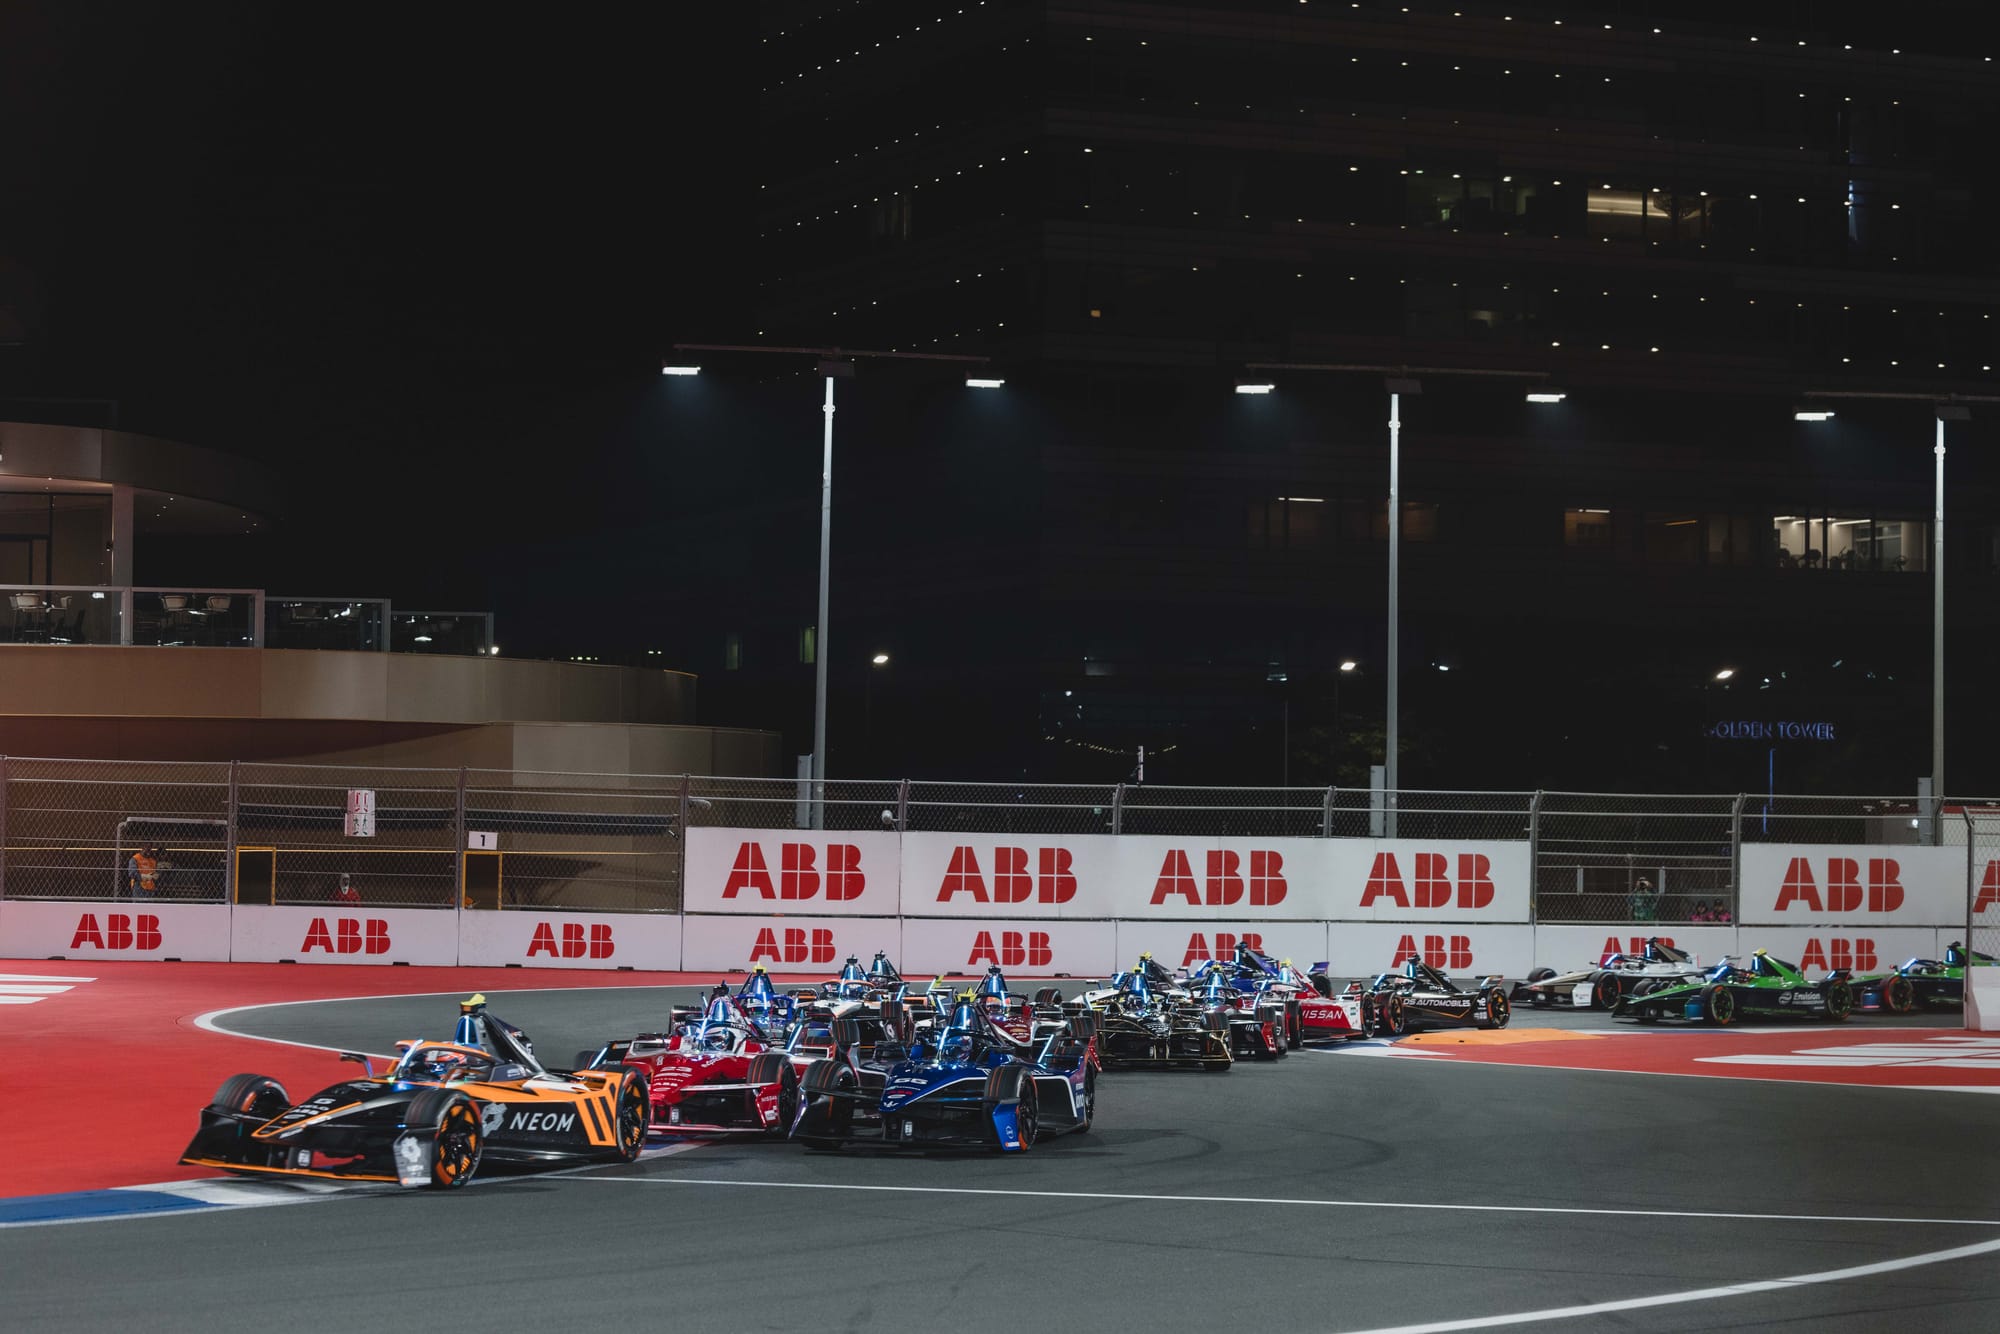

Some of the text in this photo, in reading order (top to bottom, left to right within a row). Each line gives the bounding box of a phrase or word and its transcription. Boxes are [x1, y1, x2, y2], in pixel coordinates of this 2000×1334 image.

[1777, 721, 1835, 740] TOWER
[480, 834, 486, 847] 1
[723, 843, 865, 900] ABB
[937, 847, 1076, 903] ABB
[1152, 850, 1286, 905] ABB
[1361, 854, 1493, 907] ABB
[1776, 858, 1904, 912] ABB
[70, 914, 162, 950] ABB
[301, 918, 390, 954] ABB
[528, 923, 614, 958] ABB
[750, 930, 835, 963] ABB
[968, 932, 1052, 966] ABB
[1391, 935, 1473, 969] ABB
[1801, 938, 1877, 971] ABB
[1793, 991, 1821, 1001] Envision
[509, 1112, 576, 1132] NEOM
